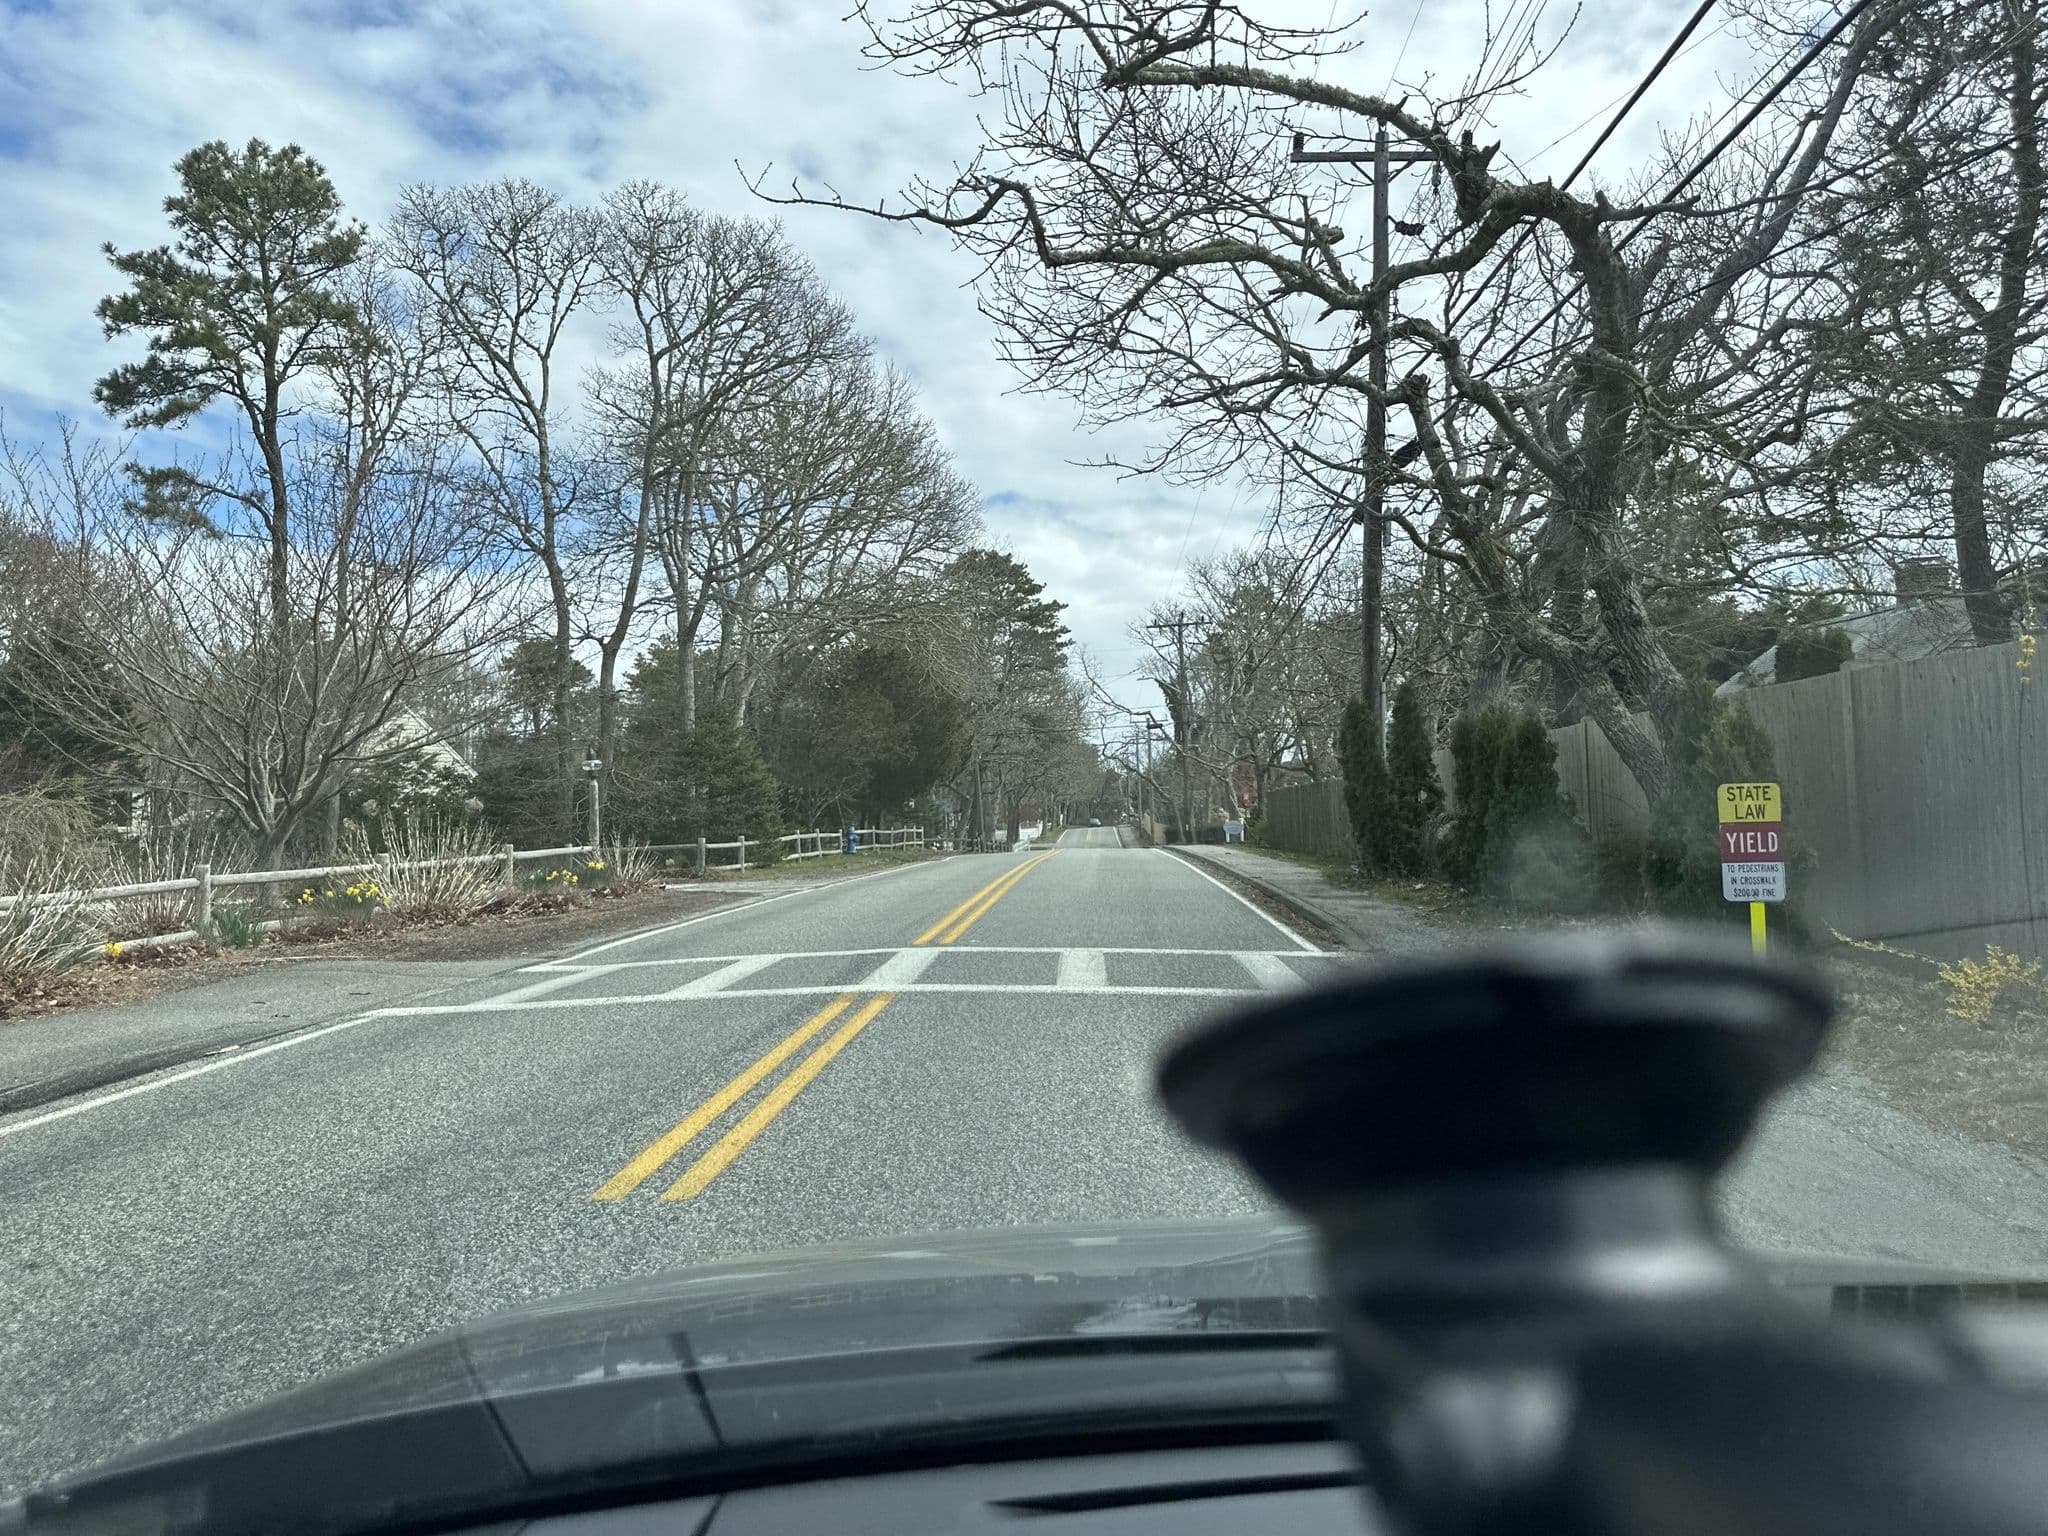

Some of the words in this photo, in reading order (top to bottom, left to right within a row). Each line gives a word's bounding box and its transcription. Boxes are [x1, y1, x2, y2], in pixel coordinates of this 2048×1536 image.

[1726, 785, 1772, 801] STATE
[1734, 804, 1766, 820] LAW
[1725, 831, 1779, 853] YIELD
[1727, 864, 1735, 873] TO
[1738, 863, 1779, 873] PEDESTRIANS
[1731, 876, 1737, 885] IN
[1740, 875, 1777, 885] CROSSWALK
[1762, 888, 1776, 897] FINE
